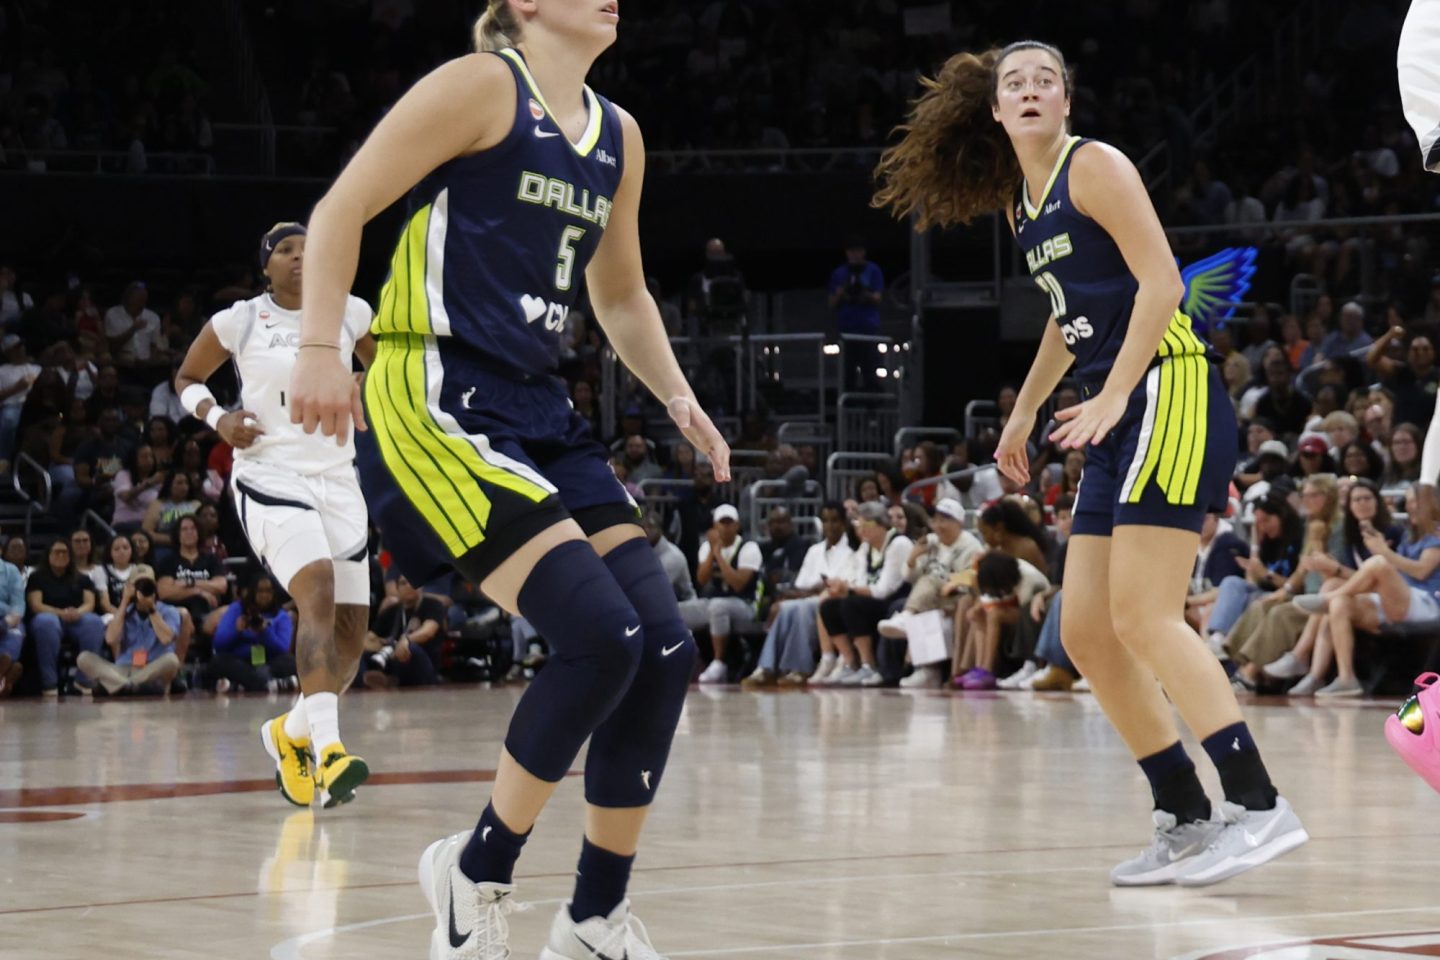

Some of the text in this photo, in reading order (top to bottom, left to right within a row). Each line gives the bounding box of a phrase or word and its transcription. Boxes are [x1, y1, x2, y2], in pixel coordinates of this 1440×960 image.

[555, 224, 587, 291] 5
[1026, 232, 1073, 275] ALLAS
[545, 301, 569, 333] CV
